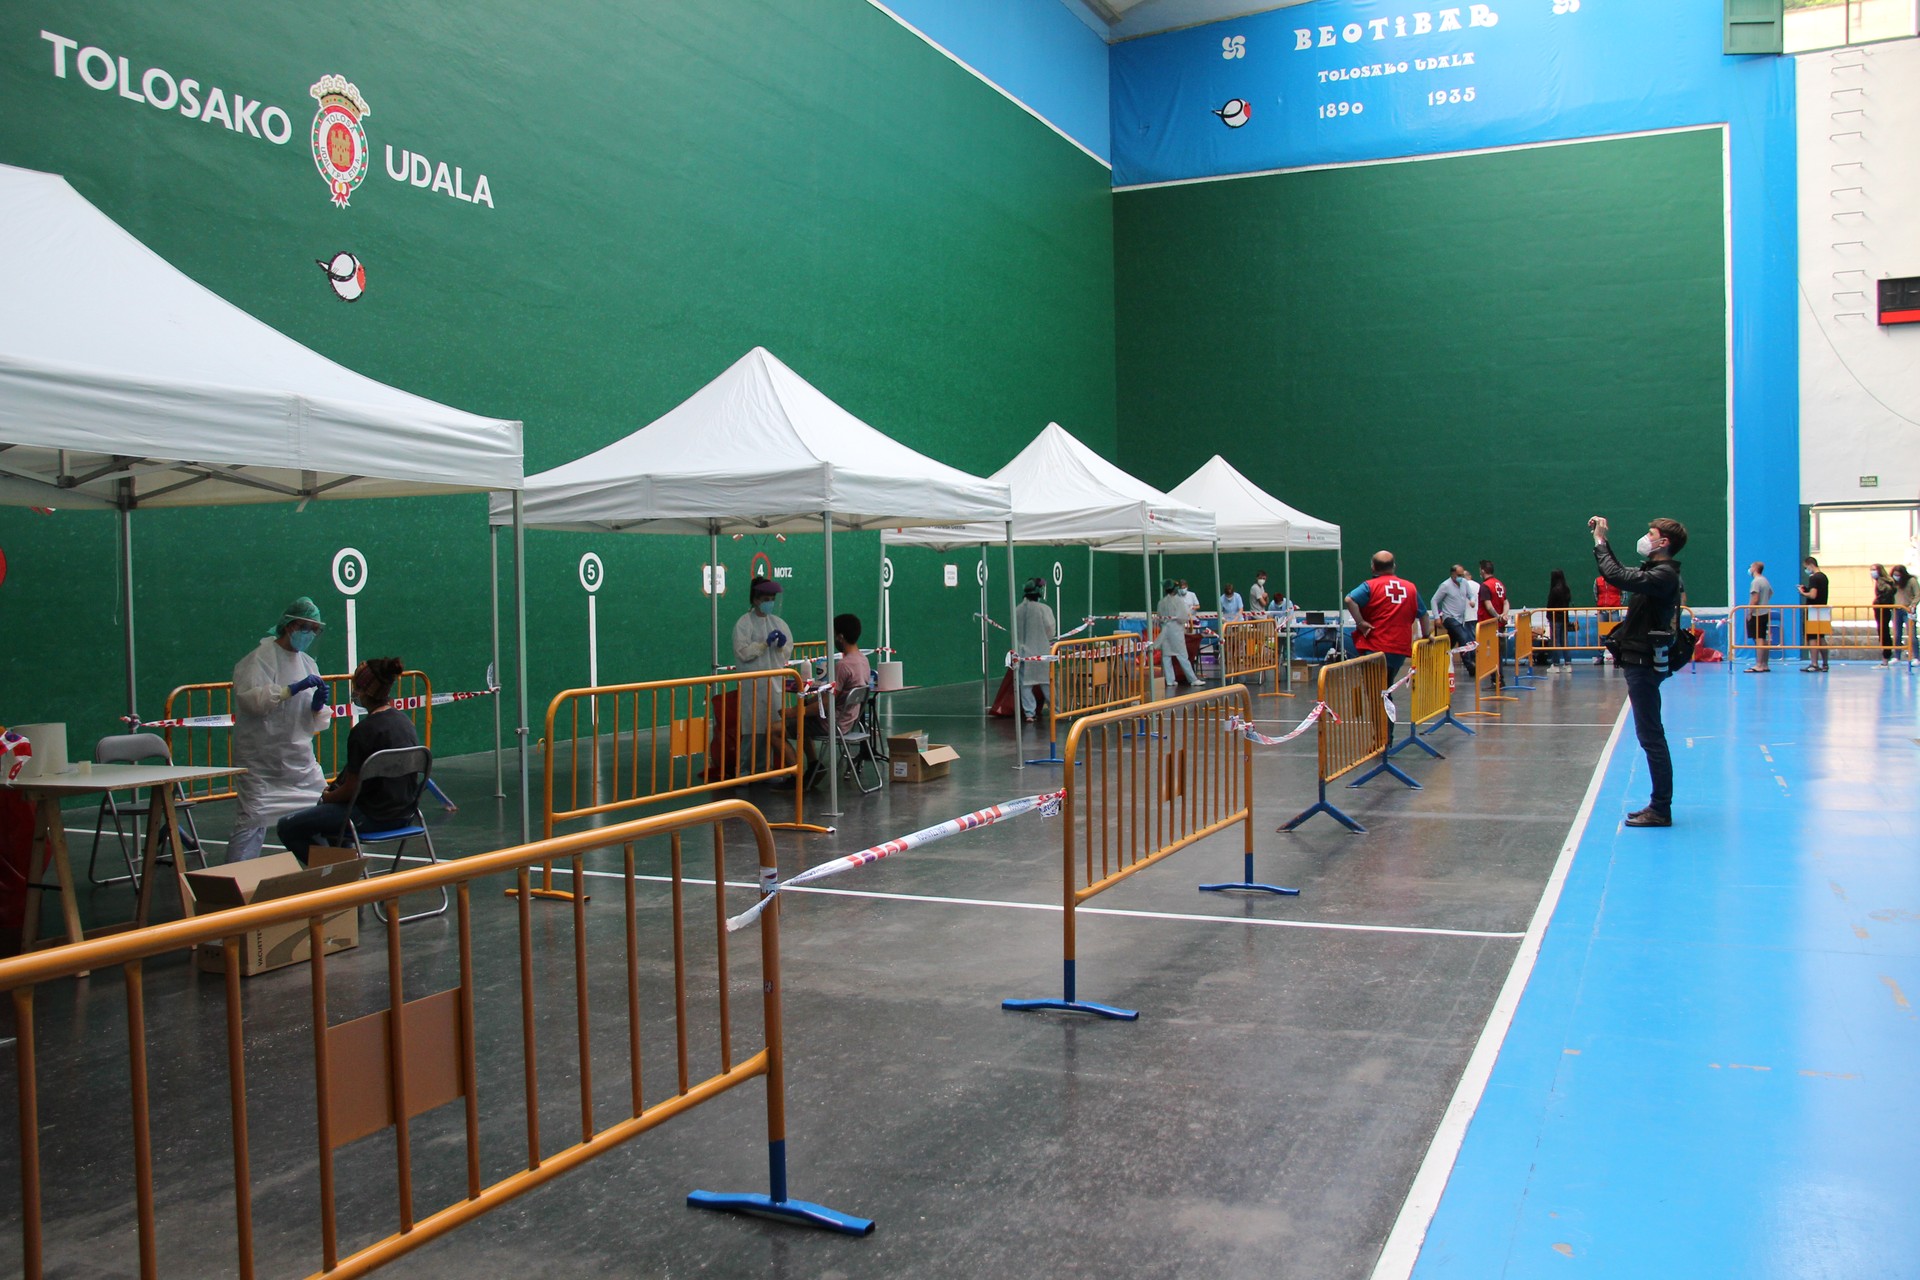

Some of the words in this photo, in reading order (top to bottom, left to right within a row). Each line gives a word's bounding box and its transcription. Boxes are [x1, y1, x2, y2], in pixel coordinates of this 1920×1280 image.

[1317, 61, 1409, 83] TOLOSAKO
[1414, 52, 1476, 71] UDALA
[1318, 101, 1364, 119] 1890
[1427, 86, 1476, 107] 1935
[40, 29, 293, 145] TOLOSAKO
[385, 144, 495, 209] UDALA
[326, 114, 355, 133] TOLOSA
[344, 561, 356, 581] 6
[587, 563, 596, 580] 5
[757, 564, 764, 577] 4
[774, 567, 793, 578] MOTZ
